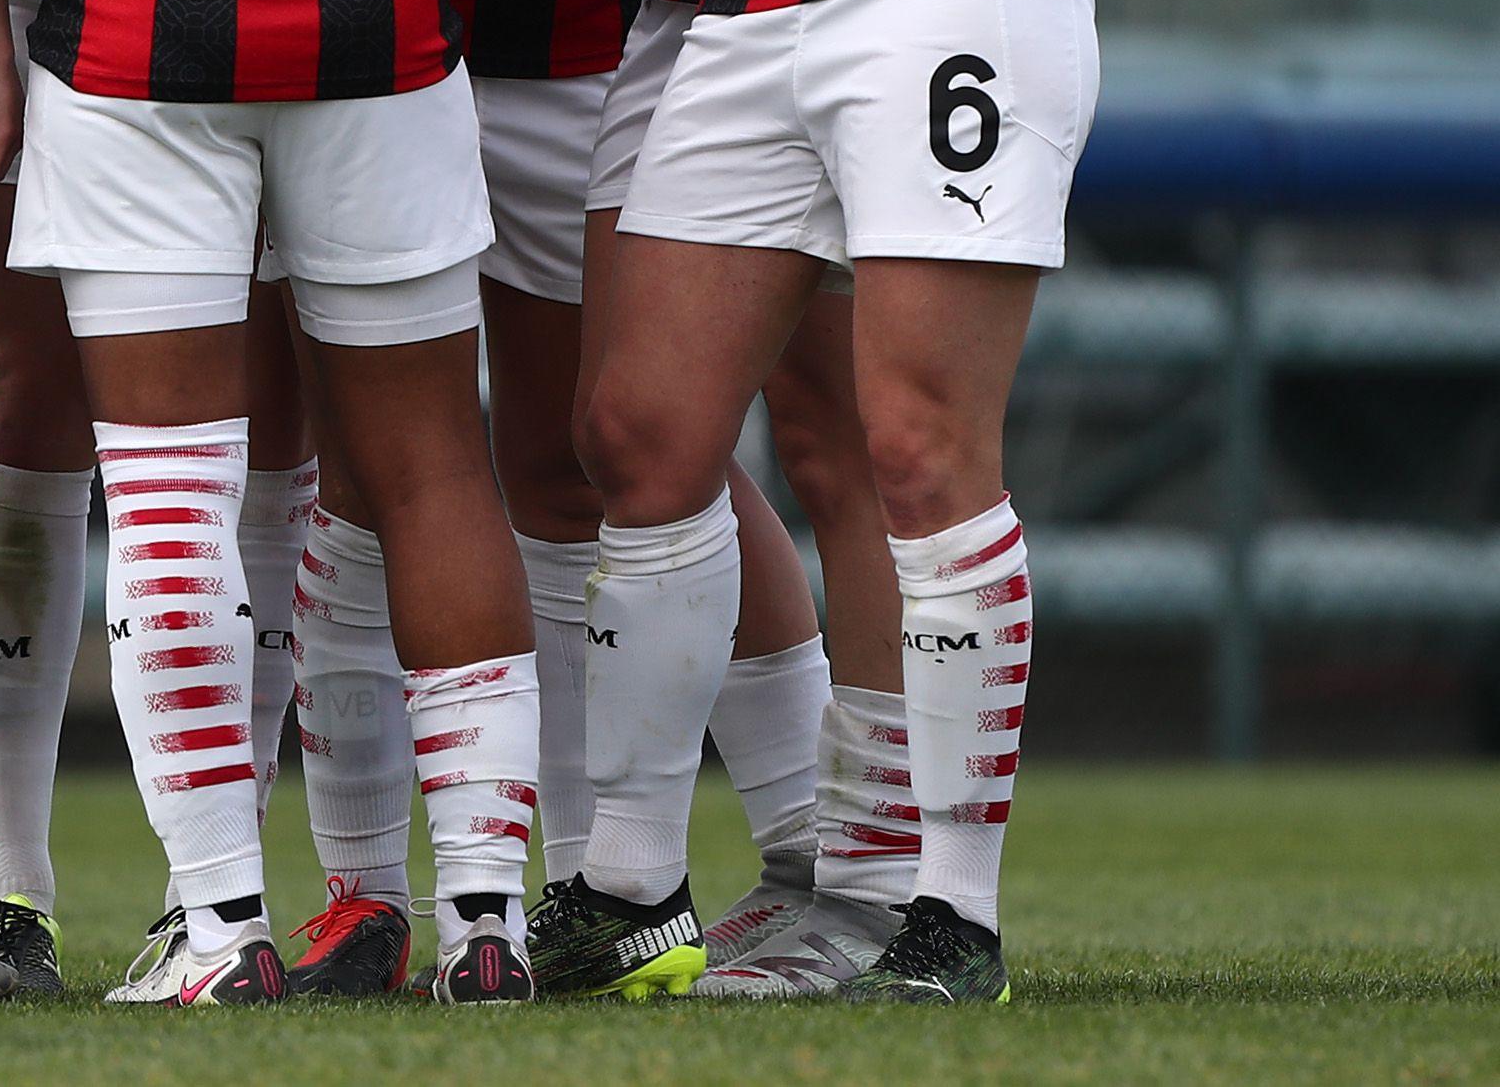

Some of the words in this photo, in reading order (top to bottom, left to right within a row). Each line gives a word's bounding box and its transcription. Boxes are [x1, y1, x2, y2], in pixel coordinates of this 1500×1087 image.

[928, 53, 1001, 173] 6
[902, 630, 982, 653] ACM
[614, 910, 700, 969] PUMA
